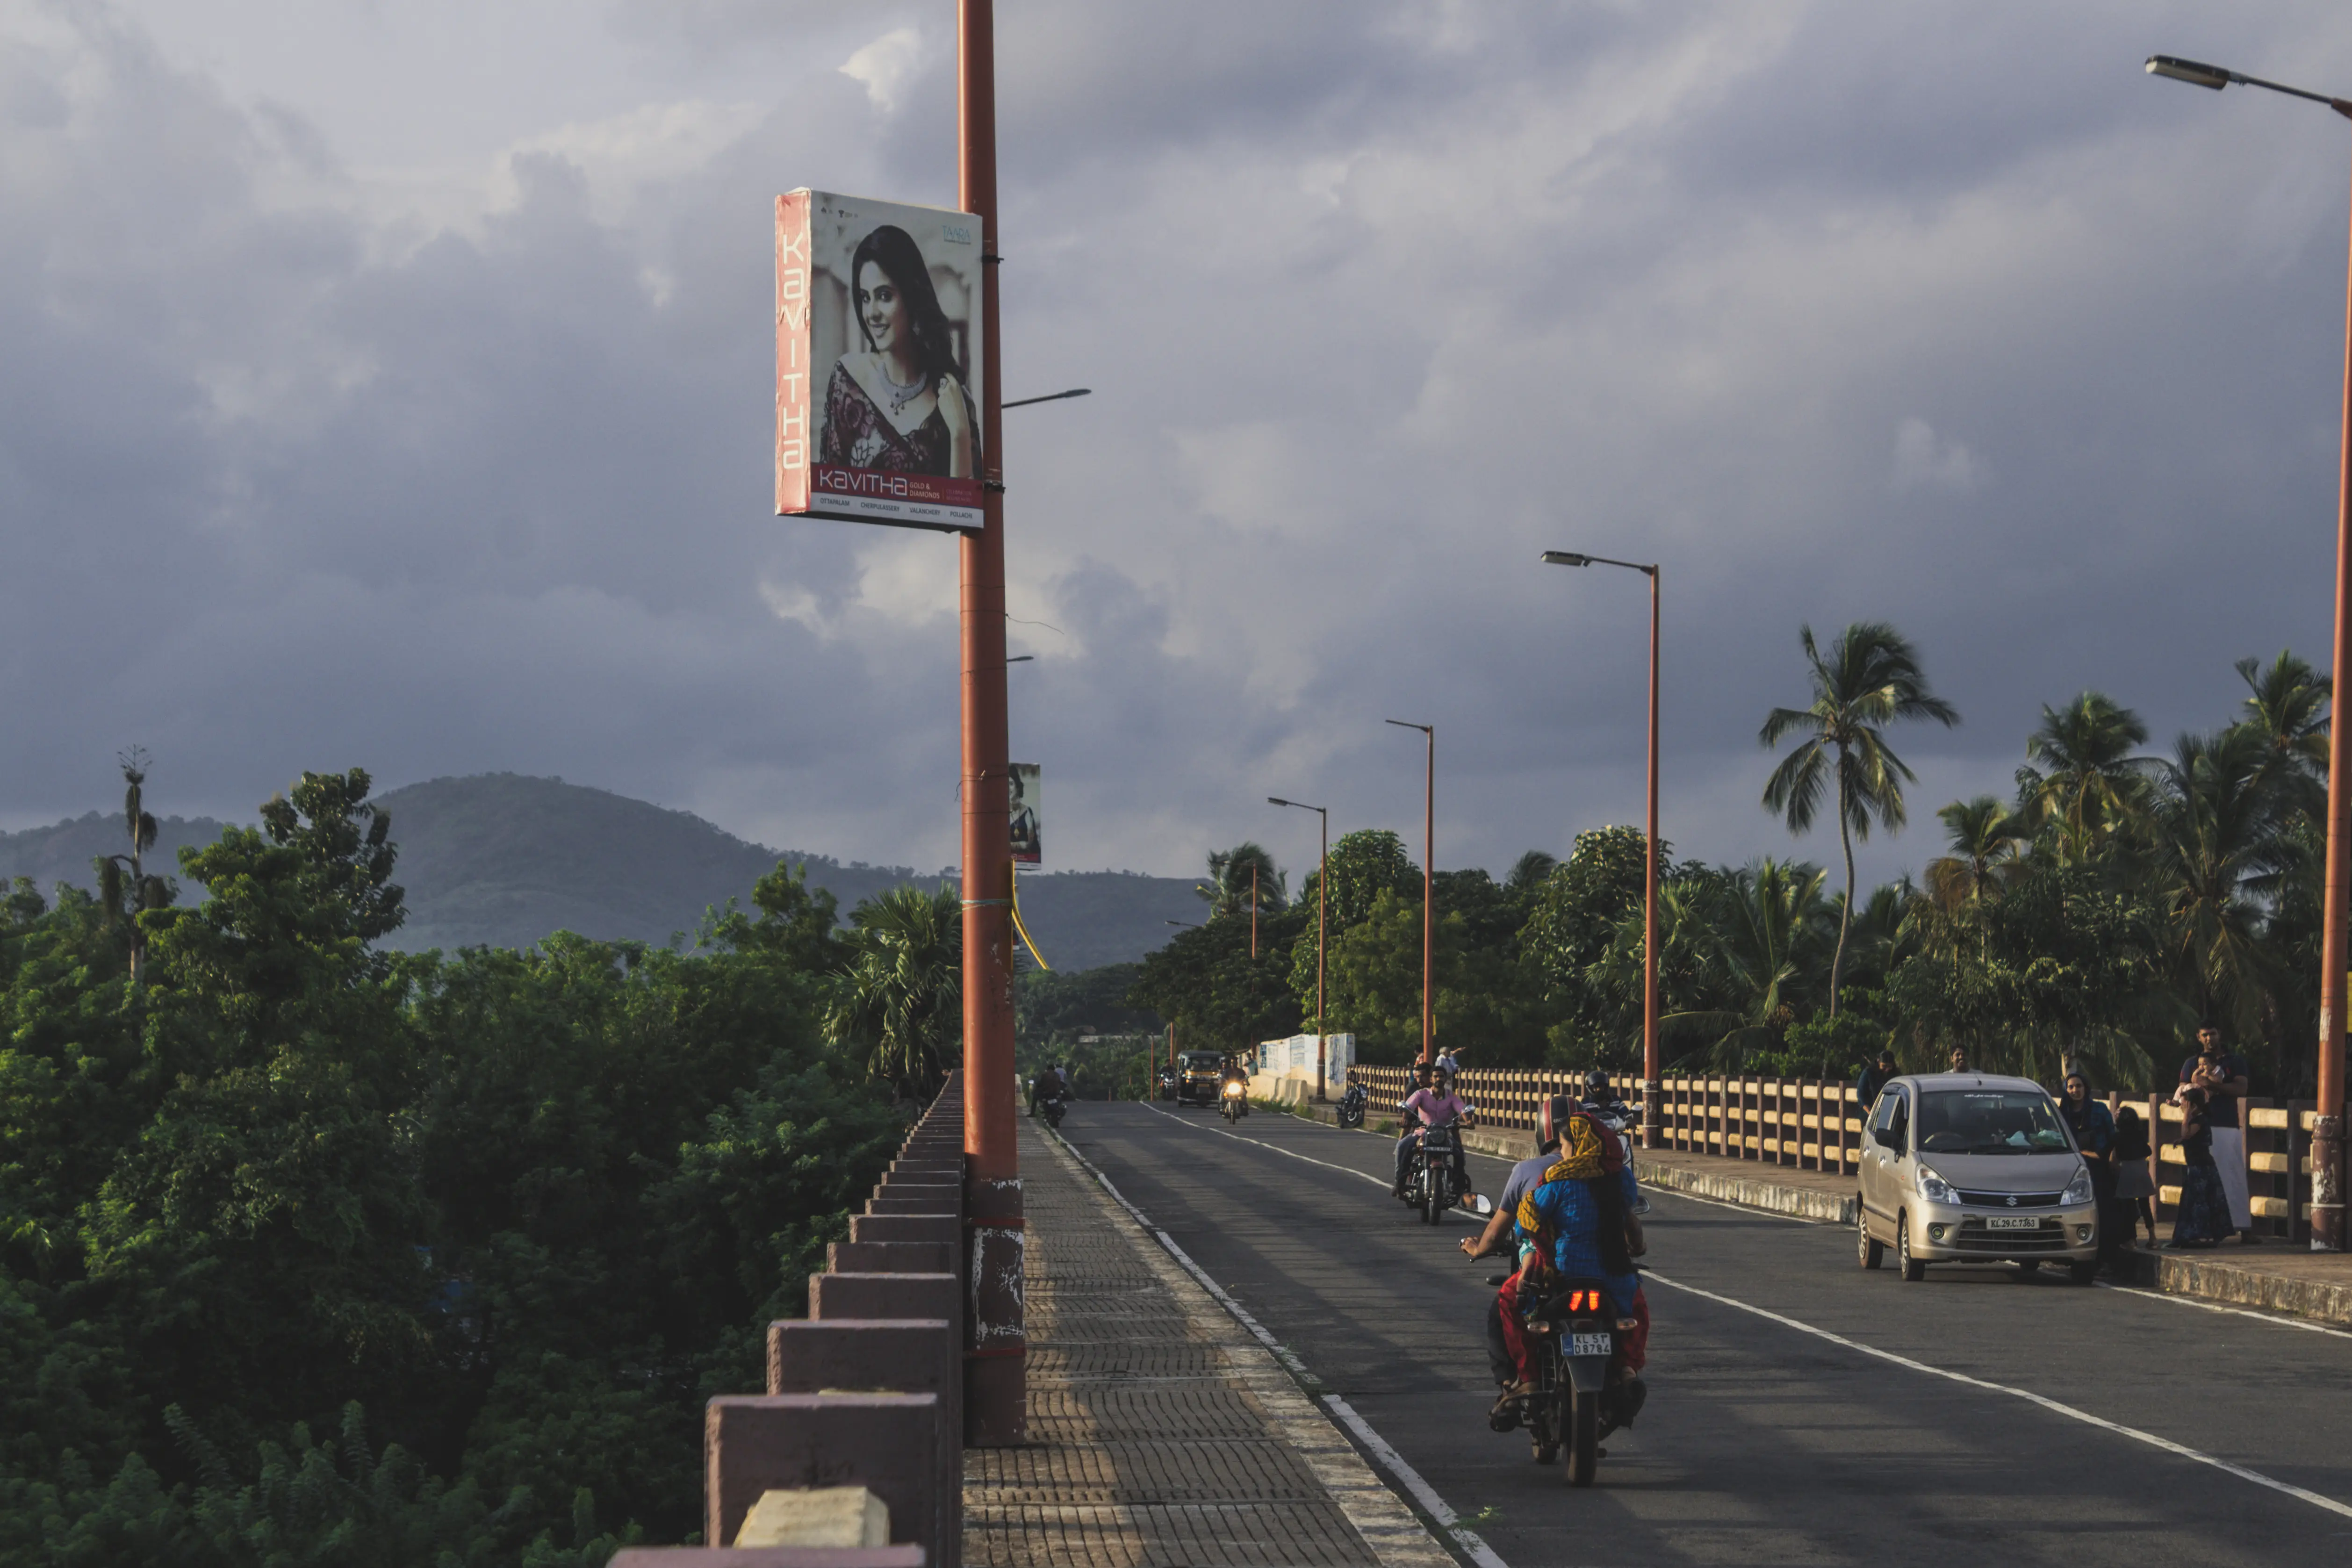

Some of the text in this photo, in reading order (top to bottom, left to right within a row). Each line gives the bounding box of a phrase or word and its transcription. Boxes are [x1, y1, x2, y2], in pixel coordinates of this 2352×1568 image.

[942, 225, 970, 241] TAARA
[909, 489, 940, 499] DIAMONDS
[820, 497, 973, 519] OTTAPALAM CHERPULASSERY VALANCHERY POLLACHI
[1576, 1335, 1589, 1344] KL
[1575, 1344, 1610, 1354] D8784
